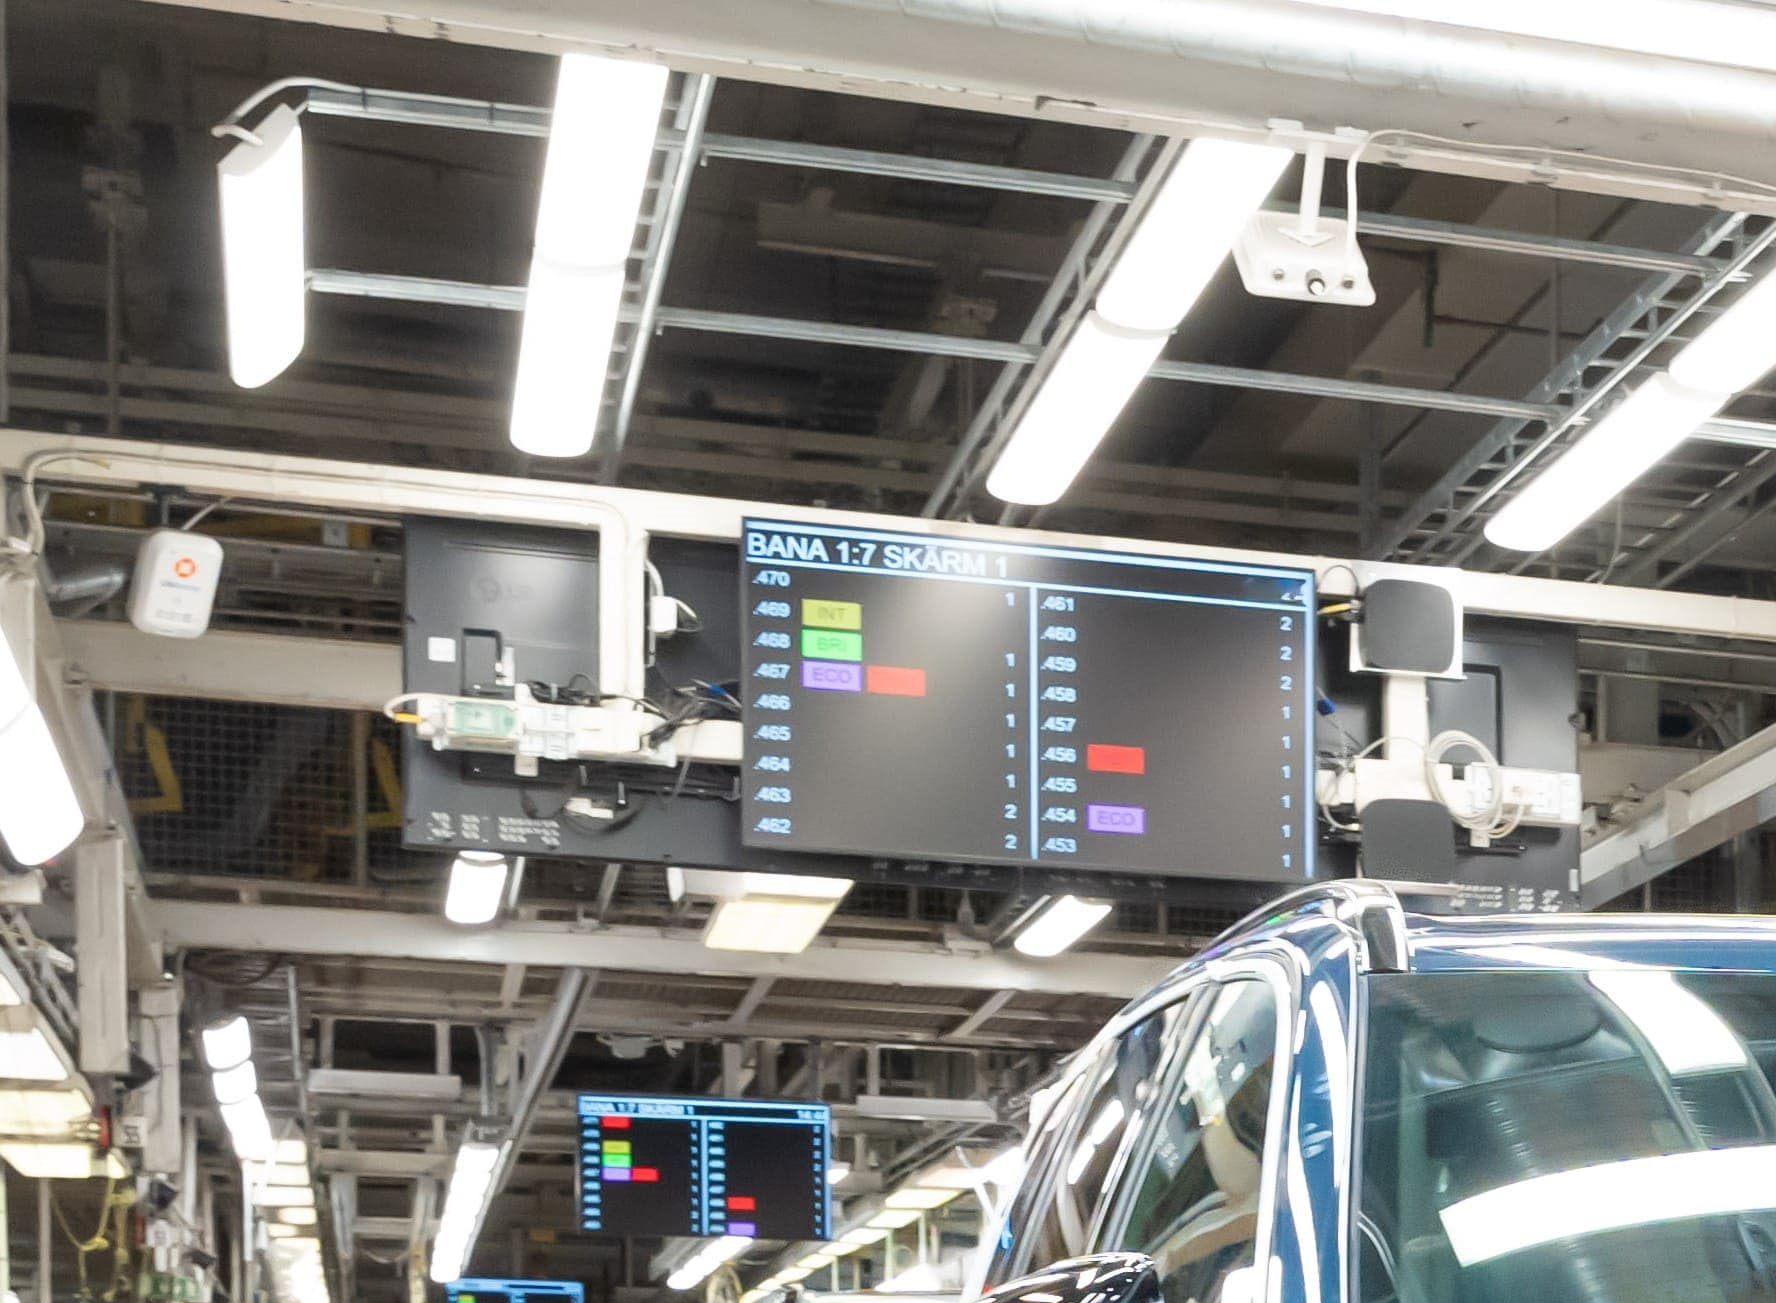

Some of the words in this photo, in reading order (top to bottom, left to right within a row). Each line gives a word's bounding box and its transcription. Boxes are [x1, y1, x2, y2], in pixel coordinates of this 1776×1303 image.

[747, 532, 829, 563] BANA
[836, 542, 877, 566] 1:7
[995, 556, 1008, 578] 1
[1004, 592, 1015, 607] 1
[1280, 616, 1293, 631] 2
[1004, 653, 1015, 668] 1
[1280, 646, 1293, 661] 2
[1004, 683, 1015, 698] 1
[1280, 676, 1293, 691] 2
[1004, 713, 1015, 728] 1
[1280, 706, 1291, 721] 1
[1280, 735, 1291, 750] 1
[1004, 744, 1015, 759] 1
[1280, 765, 1291, 780] 1
[1004, 774, 1015, 789] 1
[1280, 795, 1291, 810] 1
[1004, 804, 1017, 819] 2
[1280, 824, 1291, 839] 1
[1004, 834, 1017, 849] 2
[1280, 854, 1291, 869] 1
